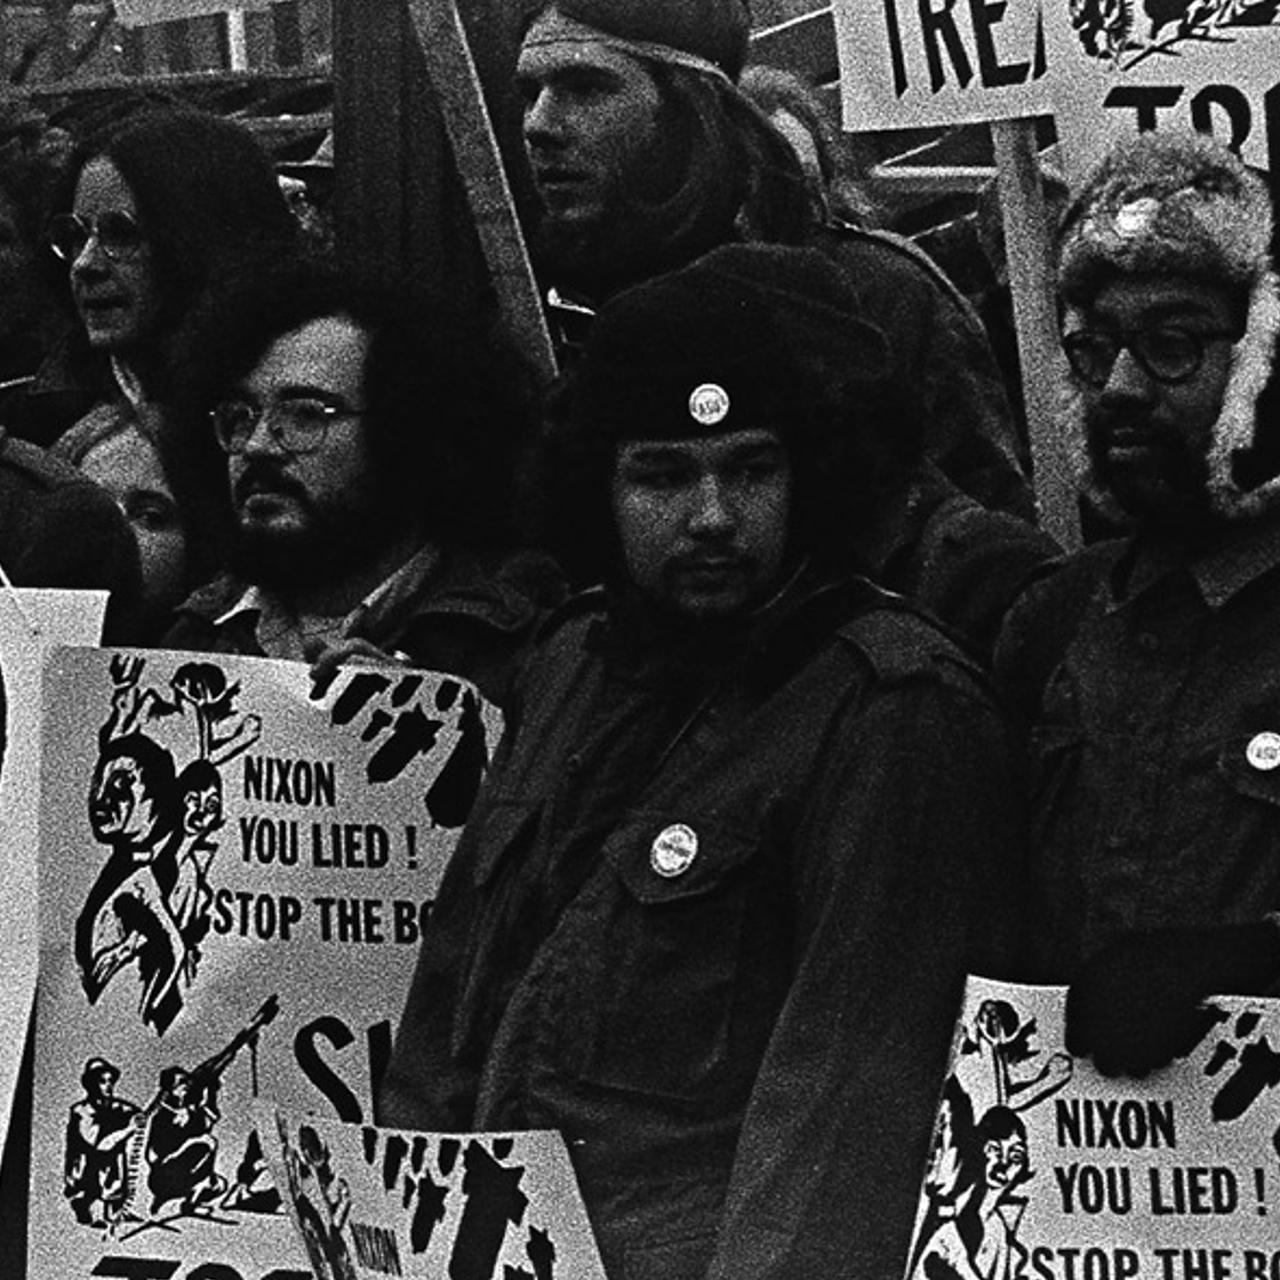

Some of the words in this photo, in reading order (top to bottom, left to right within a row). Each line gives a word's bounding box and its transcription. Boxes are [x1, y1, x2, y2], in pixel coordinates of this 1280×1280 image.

[244, 755, 336, 807] NIXON
[240, 815, 298, 866] YOU
[313, 823, 389, 868] LIED
[213, 889, 302, 941] STOP
[313, 898, 384, 942] THE
[1055, 1099, 1176, 1150] NIXON
[1053, 1162, 1131, 1215] YOU
[1149, 1167, 1238, 1215] LIED
